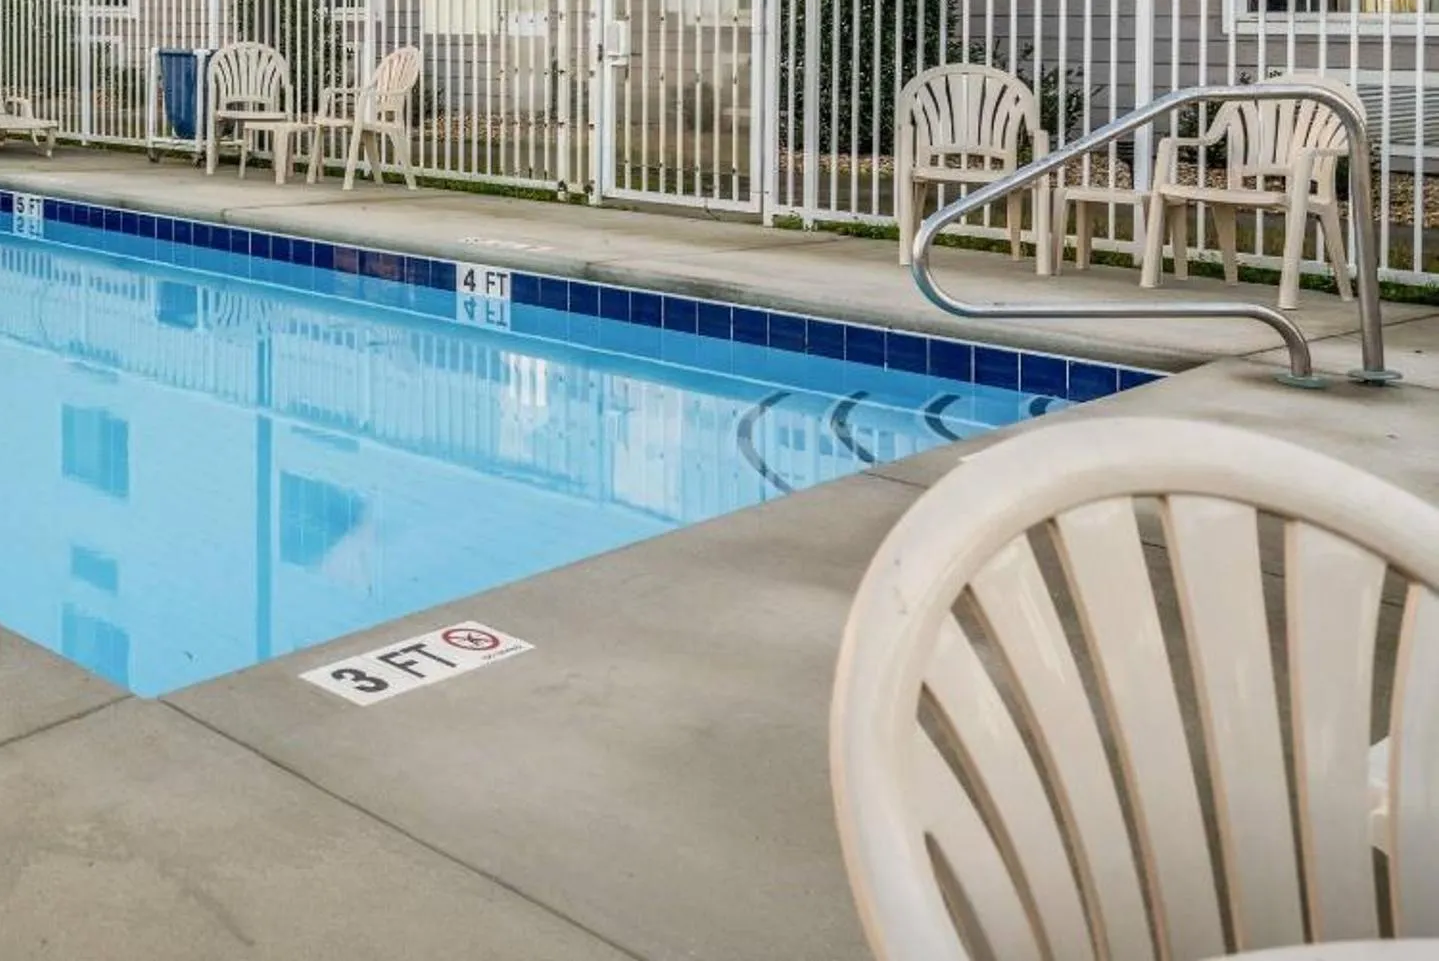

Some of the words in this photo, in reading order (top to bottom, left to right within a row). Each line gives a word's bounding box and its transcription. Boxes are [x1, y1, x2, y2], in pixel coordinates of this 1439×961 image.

[16, 196, 25, 214] 5
[29, 197, 42, 216] FT
[463, 268, 476, 292] 4
[486, 271, 508, 297] FT
[331, 668, 389, 693] 3
[376, 643, 457, 679] FT
